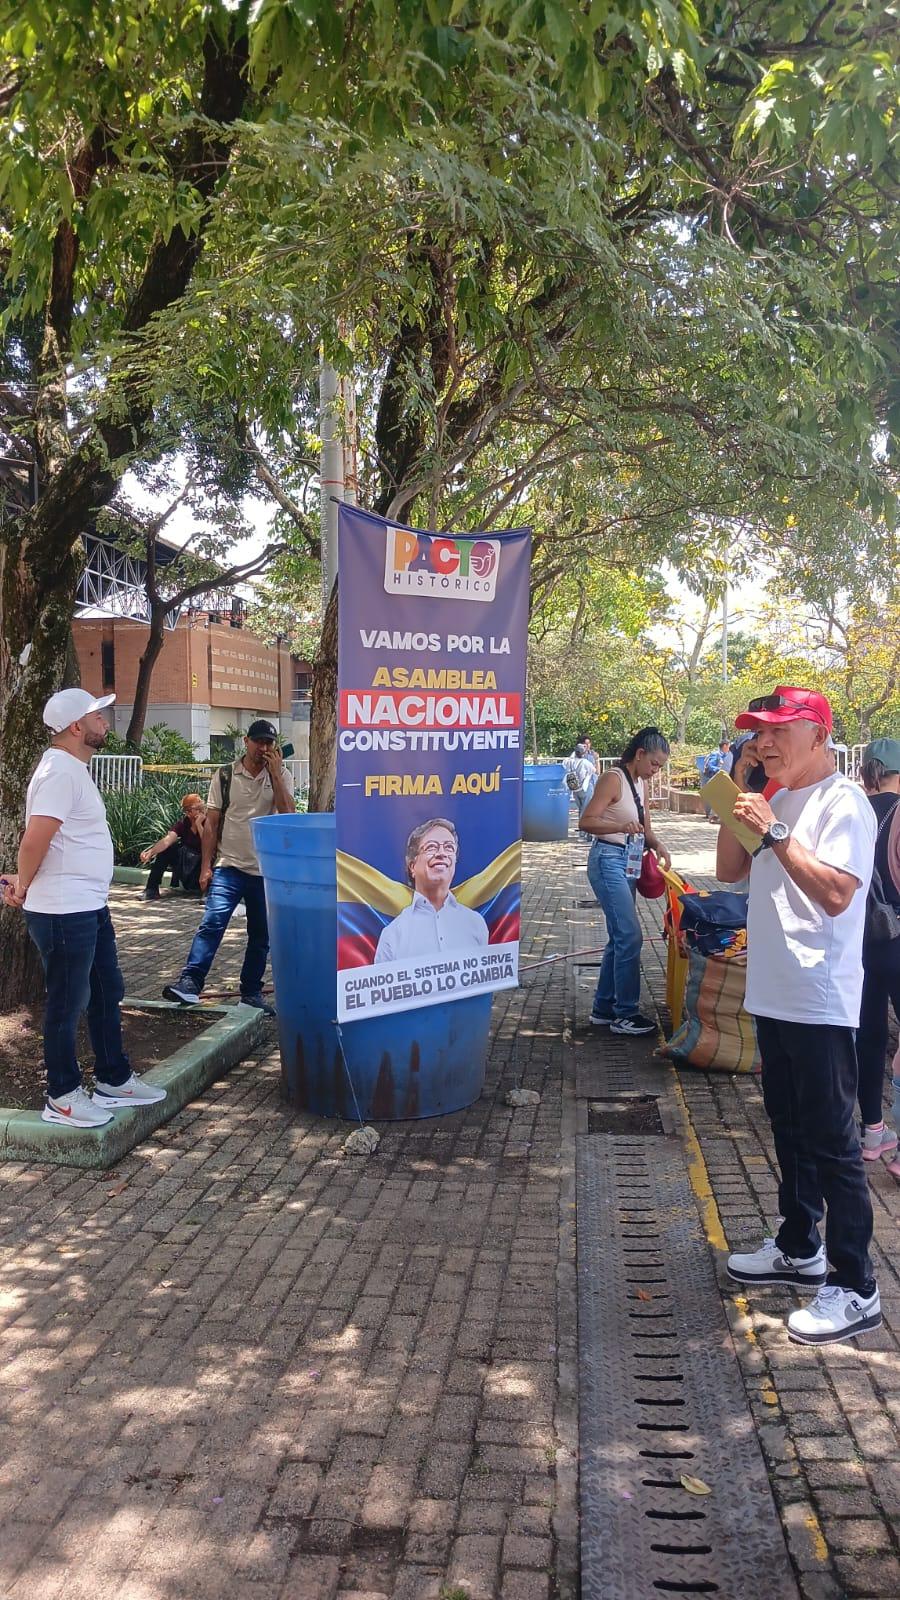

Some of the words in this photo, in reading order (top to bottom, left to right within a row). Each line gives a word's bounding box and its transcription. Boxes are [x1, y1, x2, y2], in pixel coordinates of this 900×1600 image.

[393, 531, 496, 578] PACTO
[393, 573, 491, 592] HISTÓRICO
[360, 629, 441, 652] VAMOS
[447, 634, 484, 653] POR
[490, 637, 511, 654] LA
[372, 666, 497, 690] ASAMBLEA
[347, 694, 514, 726] NACIONAL
[339, 729, 520, 751] CONSTITUYENTE
[365, 774, 443, 796] FIRMA
[451, 765, 502, 796] AQUÍ
[345, 973, 394, 992] CUANDO
[397, 971, 411, 982] EL
[414, 961, 460, 979] SISTEMA
[463, 958, 478, 970] NO
[481, 952, 514, 967] SIRVE,
[345, 994, 365, 1010] EL
[371, 980, 433, 1005] PUEBLO
[438, 975, 456, 991] LO
[460, 964, 514, 987] CAMBIA
